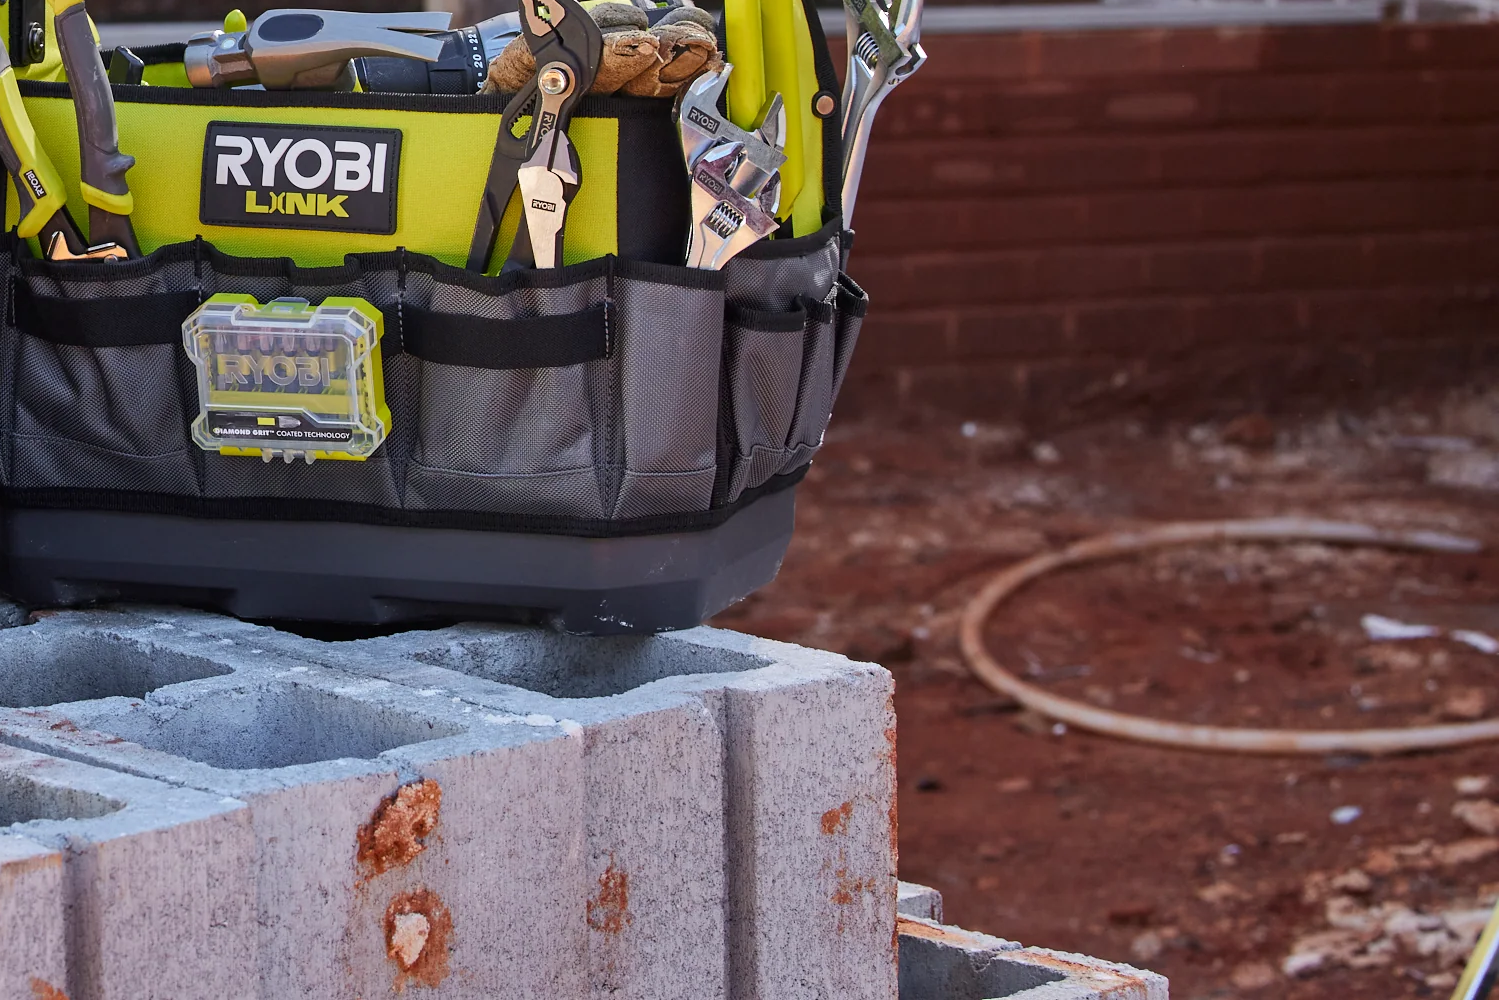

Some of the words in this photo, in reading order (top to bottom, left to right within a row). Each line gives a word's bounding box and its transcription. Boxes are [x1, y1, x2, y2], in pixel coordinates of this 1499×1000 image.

[467, 33, 479, 44] 22
[472, 53, 484, 69] 20
[540, 114, 554, 139] RYO
[688, 108, 719, 132] RYOBI
[214, 134, 388, 194] RYOBI
[25, 170, 45, 197] RYOBI
[698, 172, 724, 194] RYOBI
[245, 190, 350, 218] LINK
[532, 200, 555, 211] RYOBI
[222, 353, 331, 388] RYOBI
[213, 427, 251, 436] DIAMOND
[276, 430, 303, 438] COATED
[304, 431, 350, 439] TECHNOLOGY
